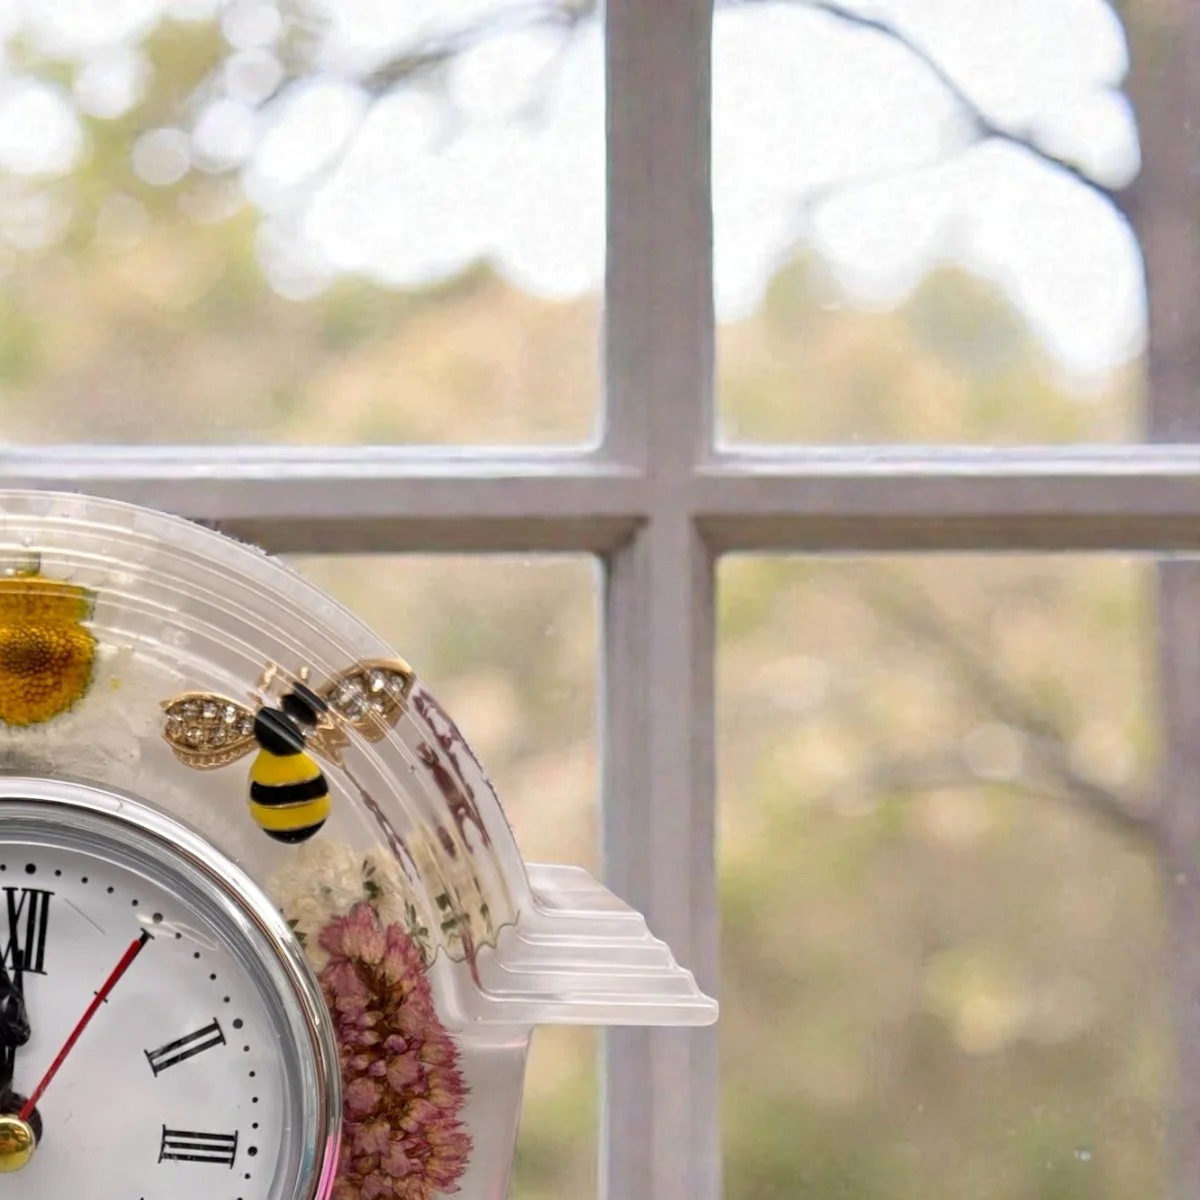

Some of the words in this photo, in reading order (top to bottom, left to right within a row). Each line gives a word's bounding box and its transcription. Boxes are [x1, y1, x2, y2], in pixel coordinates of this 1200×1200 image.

[0, 887, 55, 975] XII
[143, 1017, 227, 1078] II
[157, 1124, 239, 1170] III
